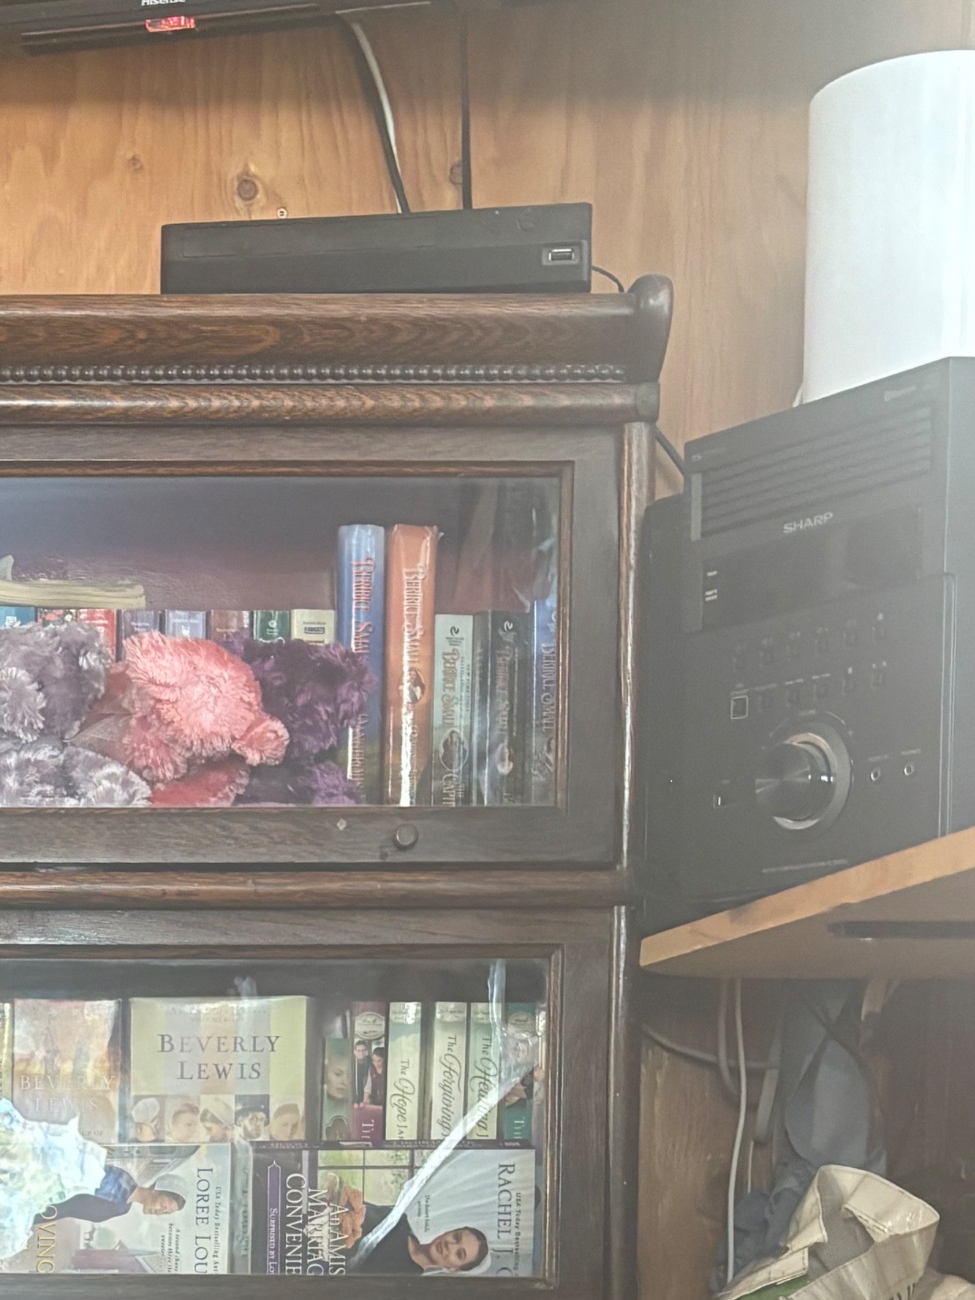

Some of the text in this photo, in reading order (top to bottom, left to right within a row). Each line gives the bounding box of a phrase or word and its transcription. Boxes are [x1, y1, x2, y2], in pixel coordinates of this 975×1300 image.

[783, 511, 834, 534] SHARP
[158, 1033, 281, 1053] BEVERLY
[482, 1037, 491, 1054] The
[176, 1061, 263, 1080] LEWIS
[437, 1034, 462, 1136] The Forgiving
[390, 1059, 415, 1125] The Hope
[196, 1168, 213, 1226] LOREE
[497, 1164, 515, 1240] RACHEL
